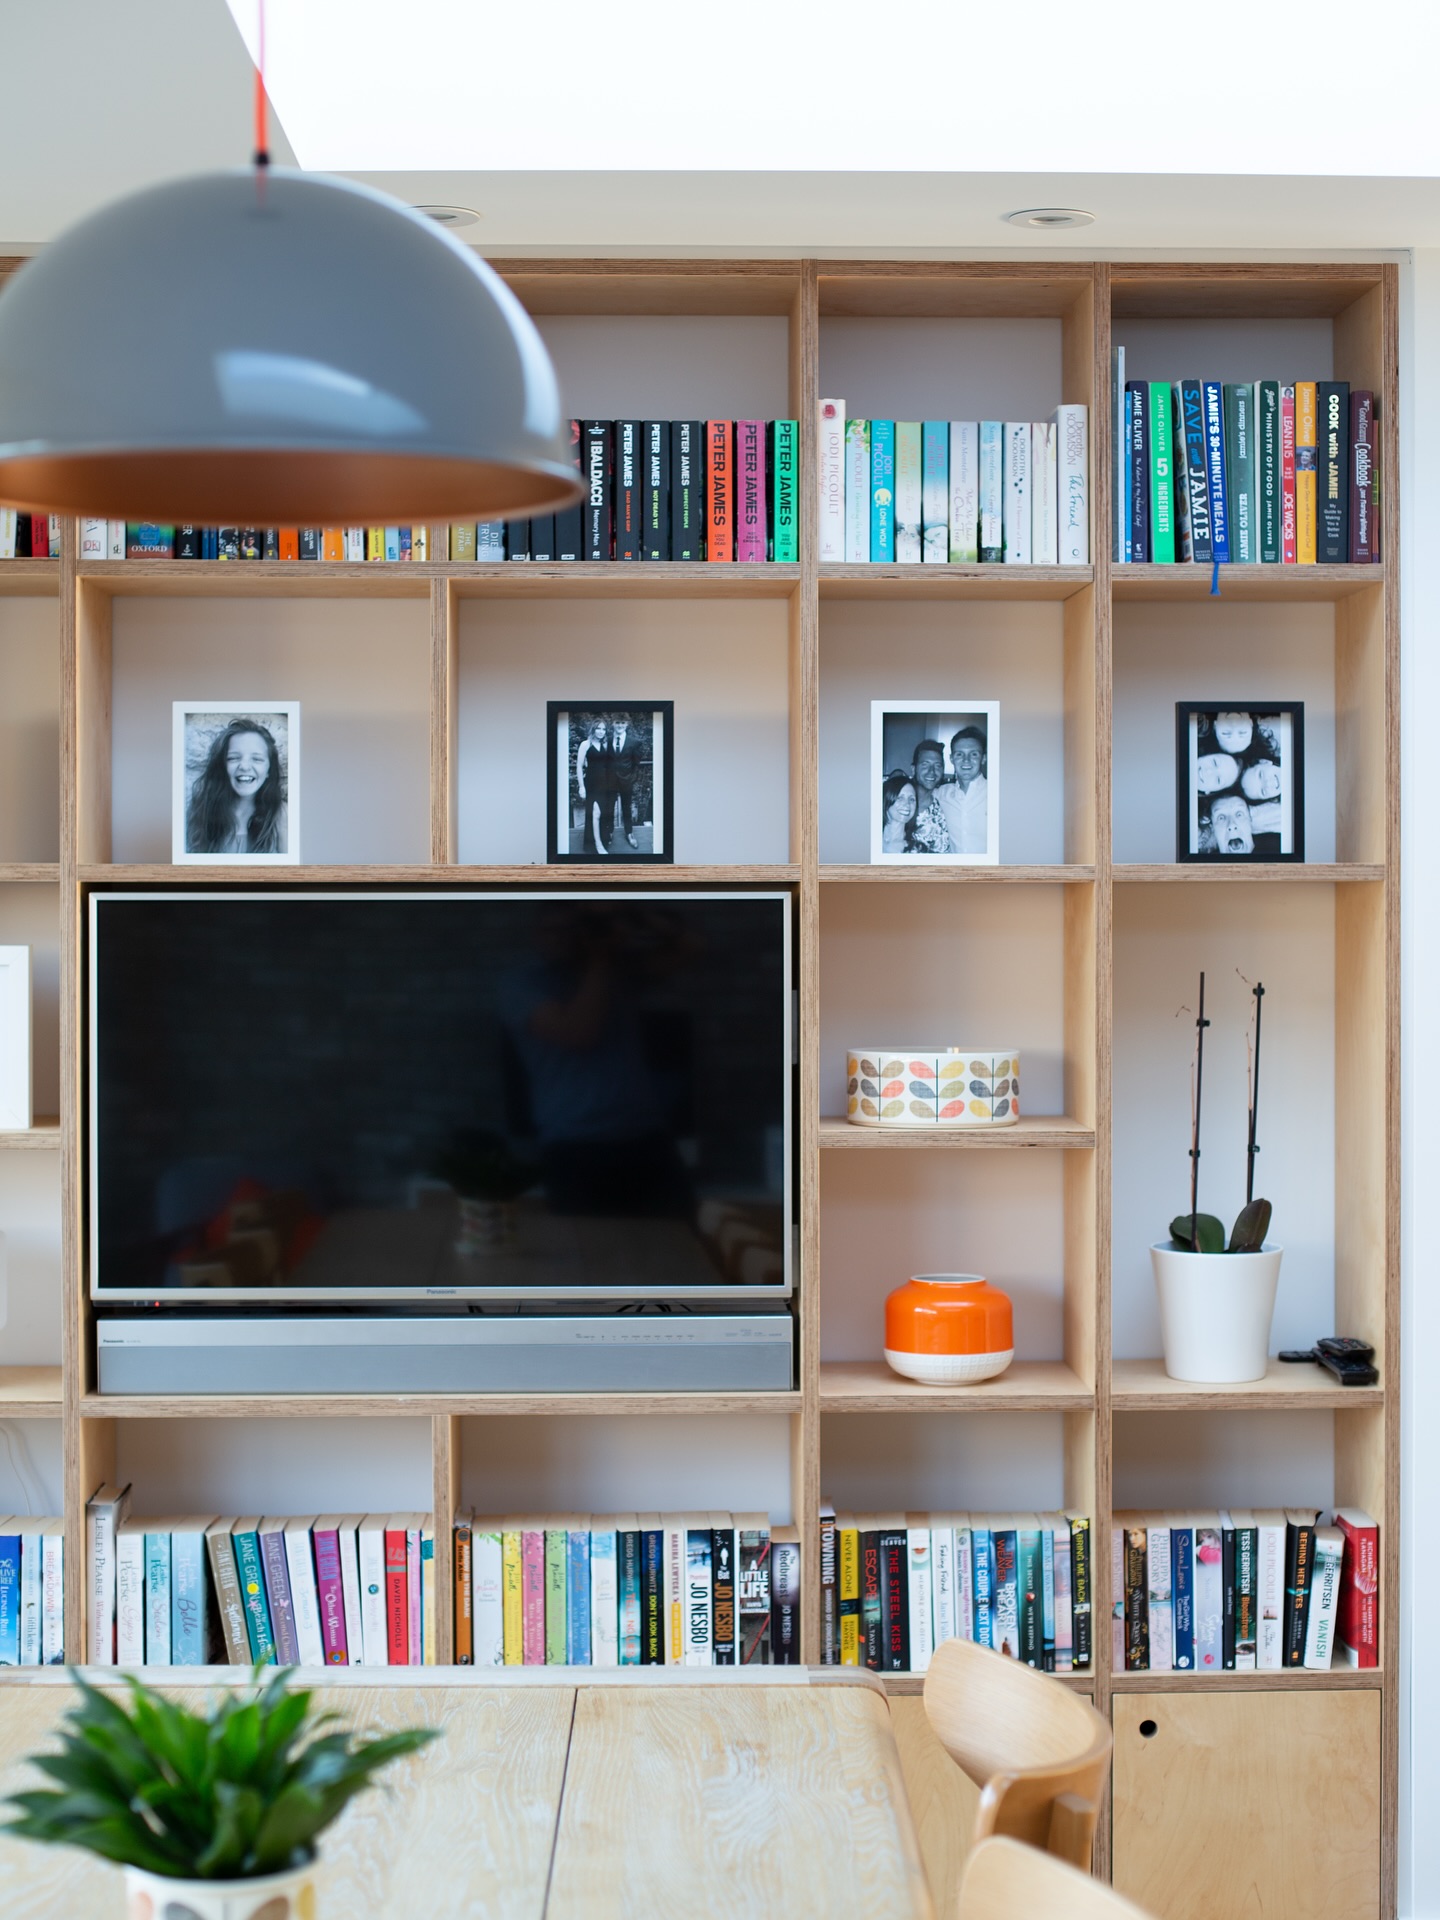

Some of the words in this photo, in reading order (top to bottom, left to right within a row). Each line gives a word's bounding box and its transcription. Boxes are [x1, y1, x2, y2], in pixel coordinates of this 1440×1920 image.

[1133, 390, 1142, 416] JAMIE
[1157, 394, 1165, 419] JAMIE
[1207, 385, 1220, 435] JAMIE'S
[1238, 400, 1247, 430] dinners
[1303, 387, 1312, 414] Jamie
[1329, 394, 1340, 430] COOK
[1183, 389, 1202, 444] SAVE
[1283, 416, 1293, 440] LEAN
[1303, 416, 1313, 444] Oliver
[624, 424, 632, 454] PETER
[651, 424, 660, 454] PETER
[681, 424, 690, 454] PETER
[714, 423, 725, 472] PETER
[745, 424, 757, 472] PETER
[780, 423, 792, 472] PETER
[829, 432, 839, 459] JODI
[1066, 413, 1076, 465] KOOMSON
[1075, 421, 1084, 458] Dorothy
[1134, 419, 1143, 450] OLIVER
[1158, 421, 1166, 451] OLIVER
[1238, 430, 1248, 459] jamie's
[1265, 412, 1273, 454] MINISTRY
[1284, 440, 1293, 450] IN
[1329, 432, 1339, 458] with
[874, 443, 883, 486] PICOULT
[884, 455, 892, 475] JODI
[1157, 457, 1168, 477] 5
[1266, 456, 1273, 468] OF
[1284, 450, 1294, 459] 15
[1353, 442, 1371, 487] Cookbook
[590, 445, 603, 506] BALDACCI
[624, 455, 632, 487] JAMES
[651, 455, 660, 487] JAMES
[681, 455, 690, 486] JAMES
[854, 453, 862, 488] PICOULT
[1070, 473, 1084, 492] The
[1329, 461, 1338, 500] JAMIE
[714, 475, 726, 526] JAMES
[745, 476, 757, 525] JAMES
[780, 475, 792, 526] JAMES
[829, 463, 839, 516] PICOULT
[1189, 467, 1210, 540] JAMIE
[1284, 491, 1293, 510] JOE
[592, 509, 600, 533] Memory
[1068, 494, 1084, 532] Friend
[1157, 482, 1169, 533] INGREDIENTS
[1213, 501, 1225, 543] MEALS
[1238, 493, 1248, 528] OLIVER
[481, 523, 489, 557] TRYING
[490, 532, 499, 547] DIE
[879, 526, 887, 547] WOLF
[1284, 510, 1294, 540] WICKS
[1239, 529, 1249, 560] JAMIE
[95, 1517, 106, 1555] LESLEY
[239, 1537, 252, 1563] JANE
[266, 1536, 279, 1562] JANE
[626, 1533, 634, 1558] GREGG
[1076, 1534, 1084, 1560] BRING
[1241, 1531, 1250, 1551] TESS
[1266, 1532, 1276, 1556] JODI
[1297, 1531, 1308, 1565] BEHIND
[750, 1560, 758, 1571] A
[822, 1527, 834, 1584] TOWNING
[889, 1550, 899, 1573] THE
[978, 1551, 987, 1570] THE
[996, 1540, 1006, 1583] WEAVER
[1005, 1550, 1013, 1569] TIM
[1076, 1563, 1084, 1577] ME
[1151, 1534, 1160, 1584] GREGORY
[1160, 1535, 1169, 1583] PHILIPPA
[45, 1551, 54, 1613] BREAKDOWN
[95, 1557, 106, 1596] PEARSE
[120, 1560, 133, 1602] Pearse
[150, 1559, 162, 1593] Pearse
[244, 1565, 260, 1600] GREN
[270, 1564, 285, 1599] GREEN
[626, 1559, 634, 1592] HURWITZ
[740, 1570, 768, 1582] LITTLE
[779, 1550, 790, 1598] Redbreast
[845, 1565, 853, 1594] ALONE
[865, 1549, 877, 1601] ESCAPE
[976, 1570, 988, 1603] COUPLE
[1241, 1552, 1250, 1595] GERRITSEN
[1266, 1558, 1277, 1601] PICOULT
[1296, 1567, 1306, 1585] HER
[1321, 1562, 1336, 1610] GERRITSEN
[393, 1578, 401, 1604] DAVID
[625, 1593, 635, 1616] TELL
[649, 1595, 657, 1616] DON'T
[690, 1582, 708, 1599] JO
[714, 1583, 733, 1599] JO
[740, 1583, 769, 1598] LIFE
[890, 1579, 900, 1619] STEEL
[1077, 1579, 1085, 1603] BACK
[1295, 1588, 1304, 1609] EYES
[177, 1597, 198, 1638] Belle
[714, 1601, 733, 1641] NESBO
[782, 1604, 791, 1614] JO
[978, 1604, 989, 1625] NEXT
[996, 1588, 1007, 1627] HEART
[1005, 1582, 1016, 1631] BROKEN
[1241, 1596, 1250, 1640] Bloodstream
[393, 1607, 402, 1648] NICHOLLS
[649, 1617, 657, 1637] LOOK
[690, 1603, 708, 1644] NESBO
[782, 1616, 792, 1644] NESBO
[890, 1625, 901, 1652] KISS
[1315, 1619, 1330, 1658] VANISH
[650, 1638, 658, 1658] BACK
